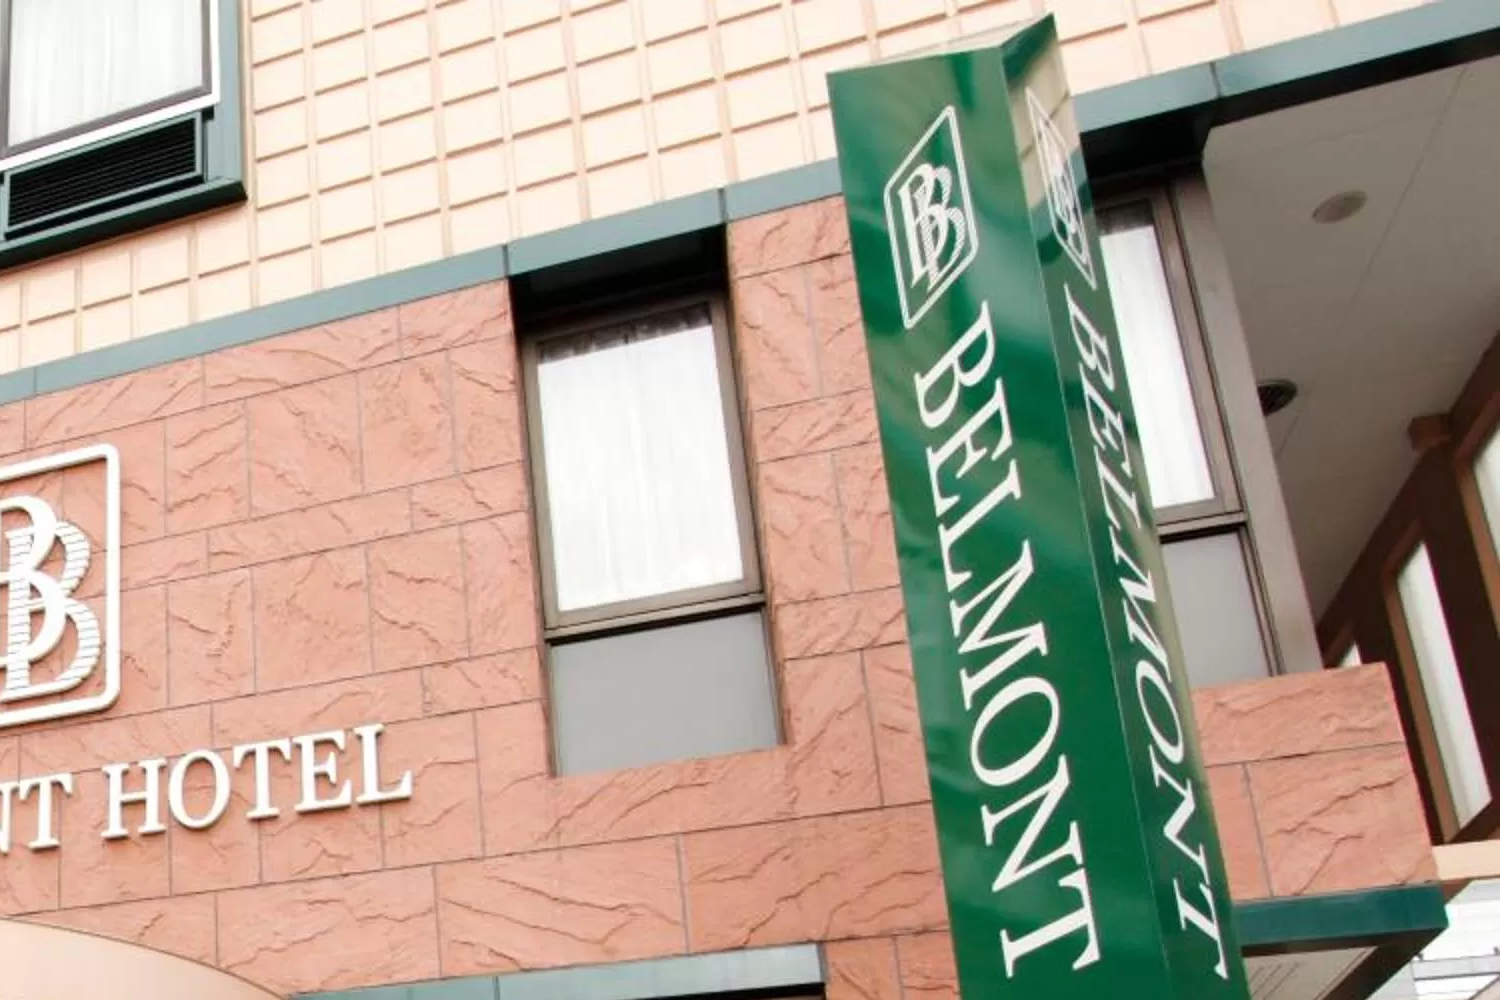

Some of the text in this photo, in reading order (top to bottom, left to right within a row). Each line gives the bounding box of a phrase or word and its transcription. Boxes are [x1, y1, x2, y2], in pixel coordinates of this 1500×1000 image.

[102, 723, 414, 842] HOTEL
[914, 301, 1101, 978] BELMONT
[1064, 284, 1228, 980] BELMONT
